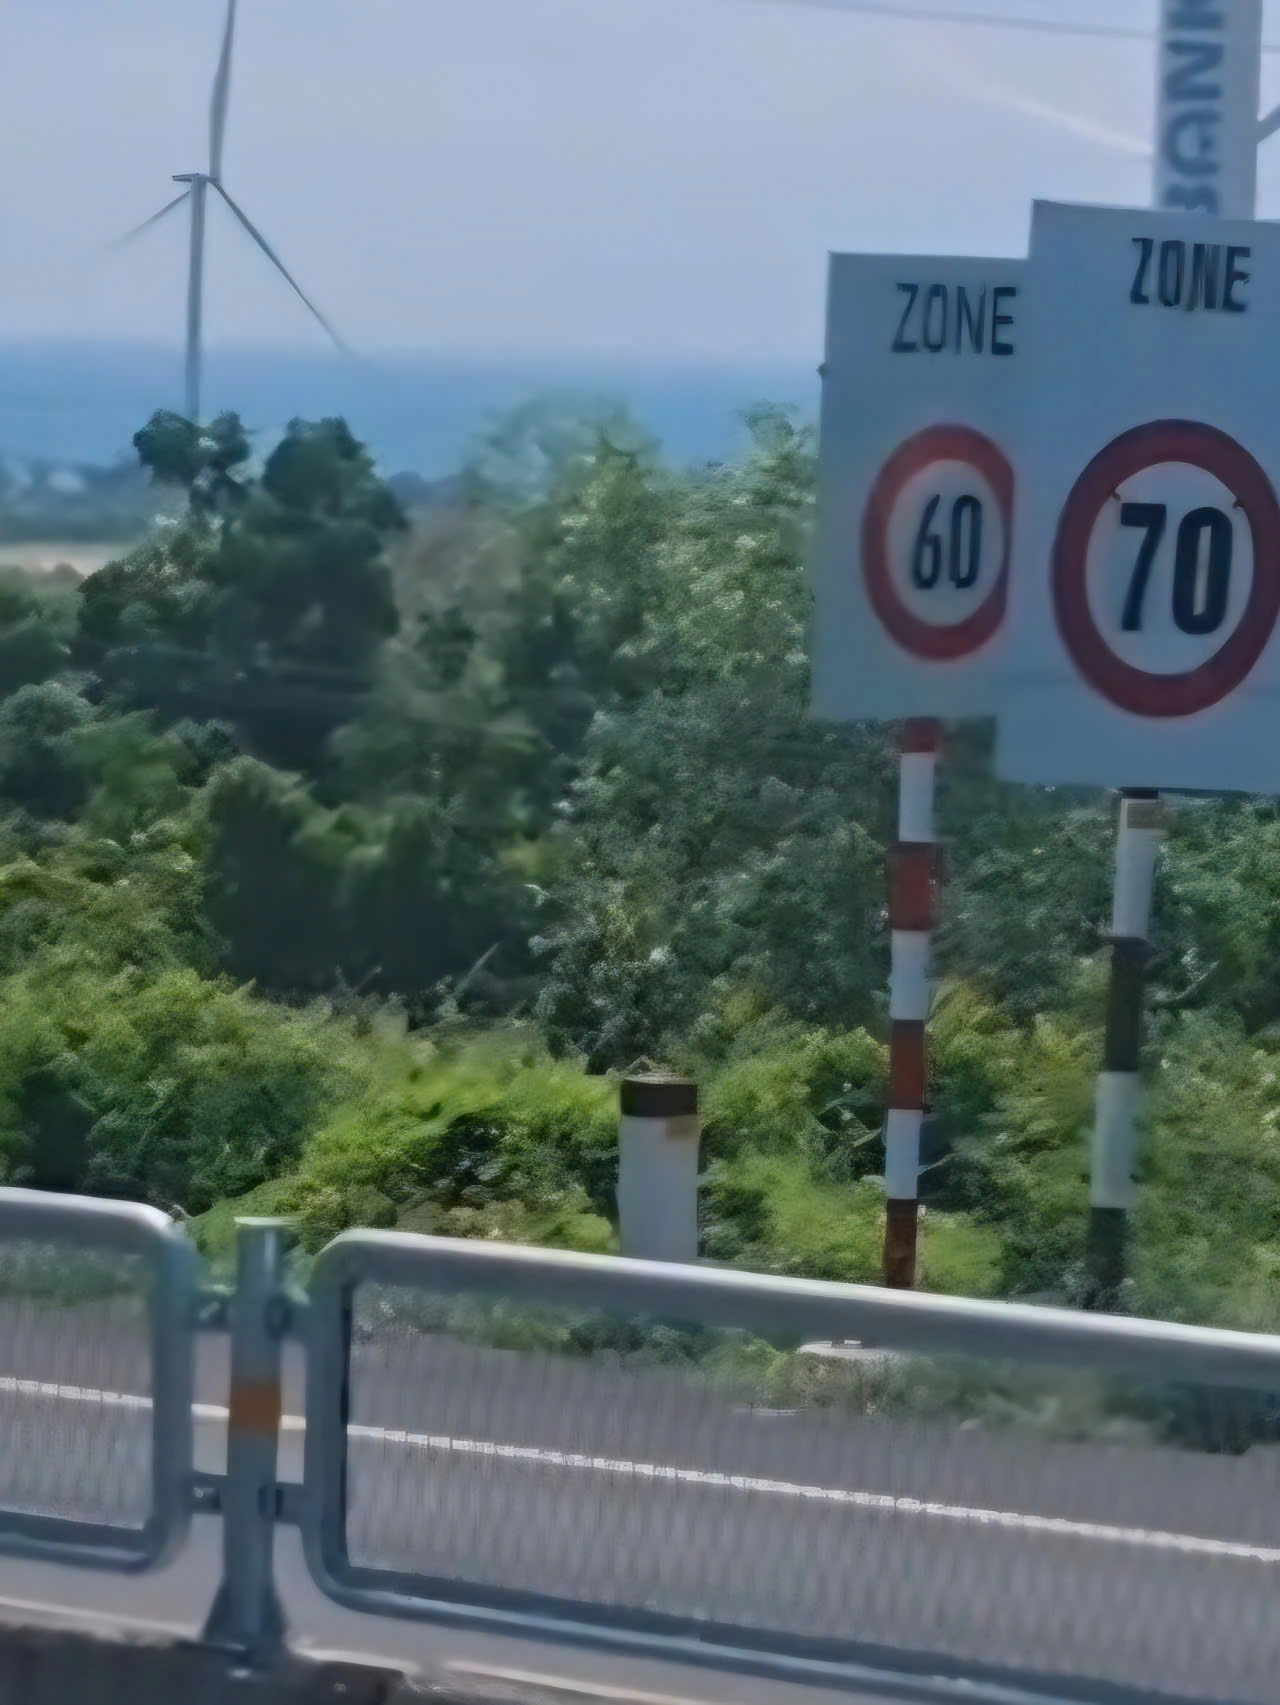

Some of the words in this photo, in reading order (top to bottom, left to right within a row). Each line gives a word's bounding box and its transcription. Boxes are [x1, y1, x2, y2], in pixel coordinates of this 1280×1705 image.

[891, 281, 1018, 356] ZONE
[1129, 236, 1252, 314] ZONE
[911, 493, 983, 591] 60
[1119, 501, 1234, 636] 70
